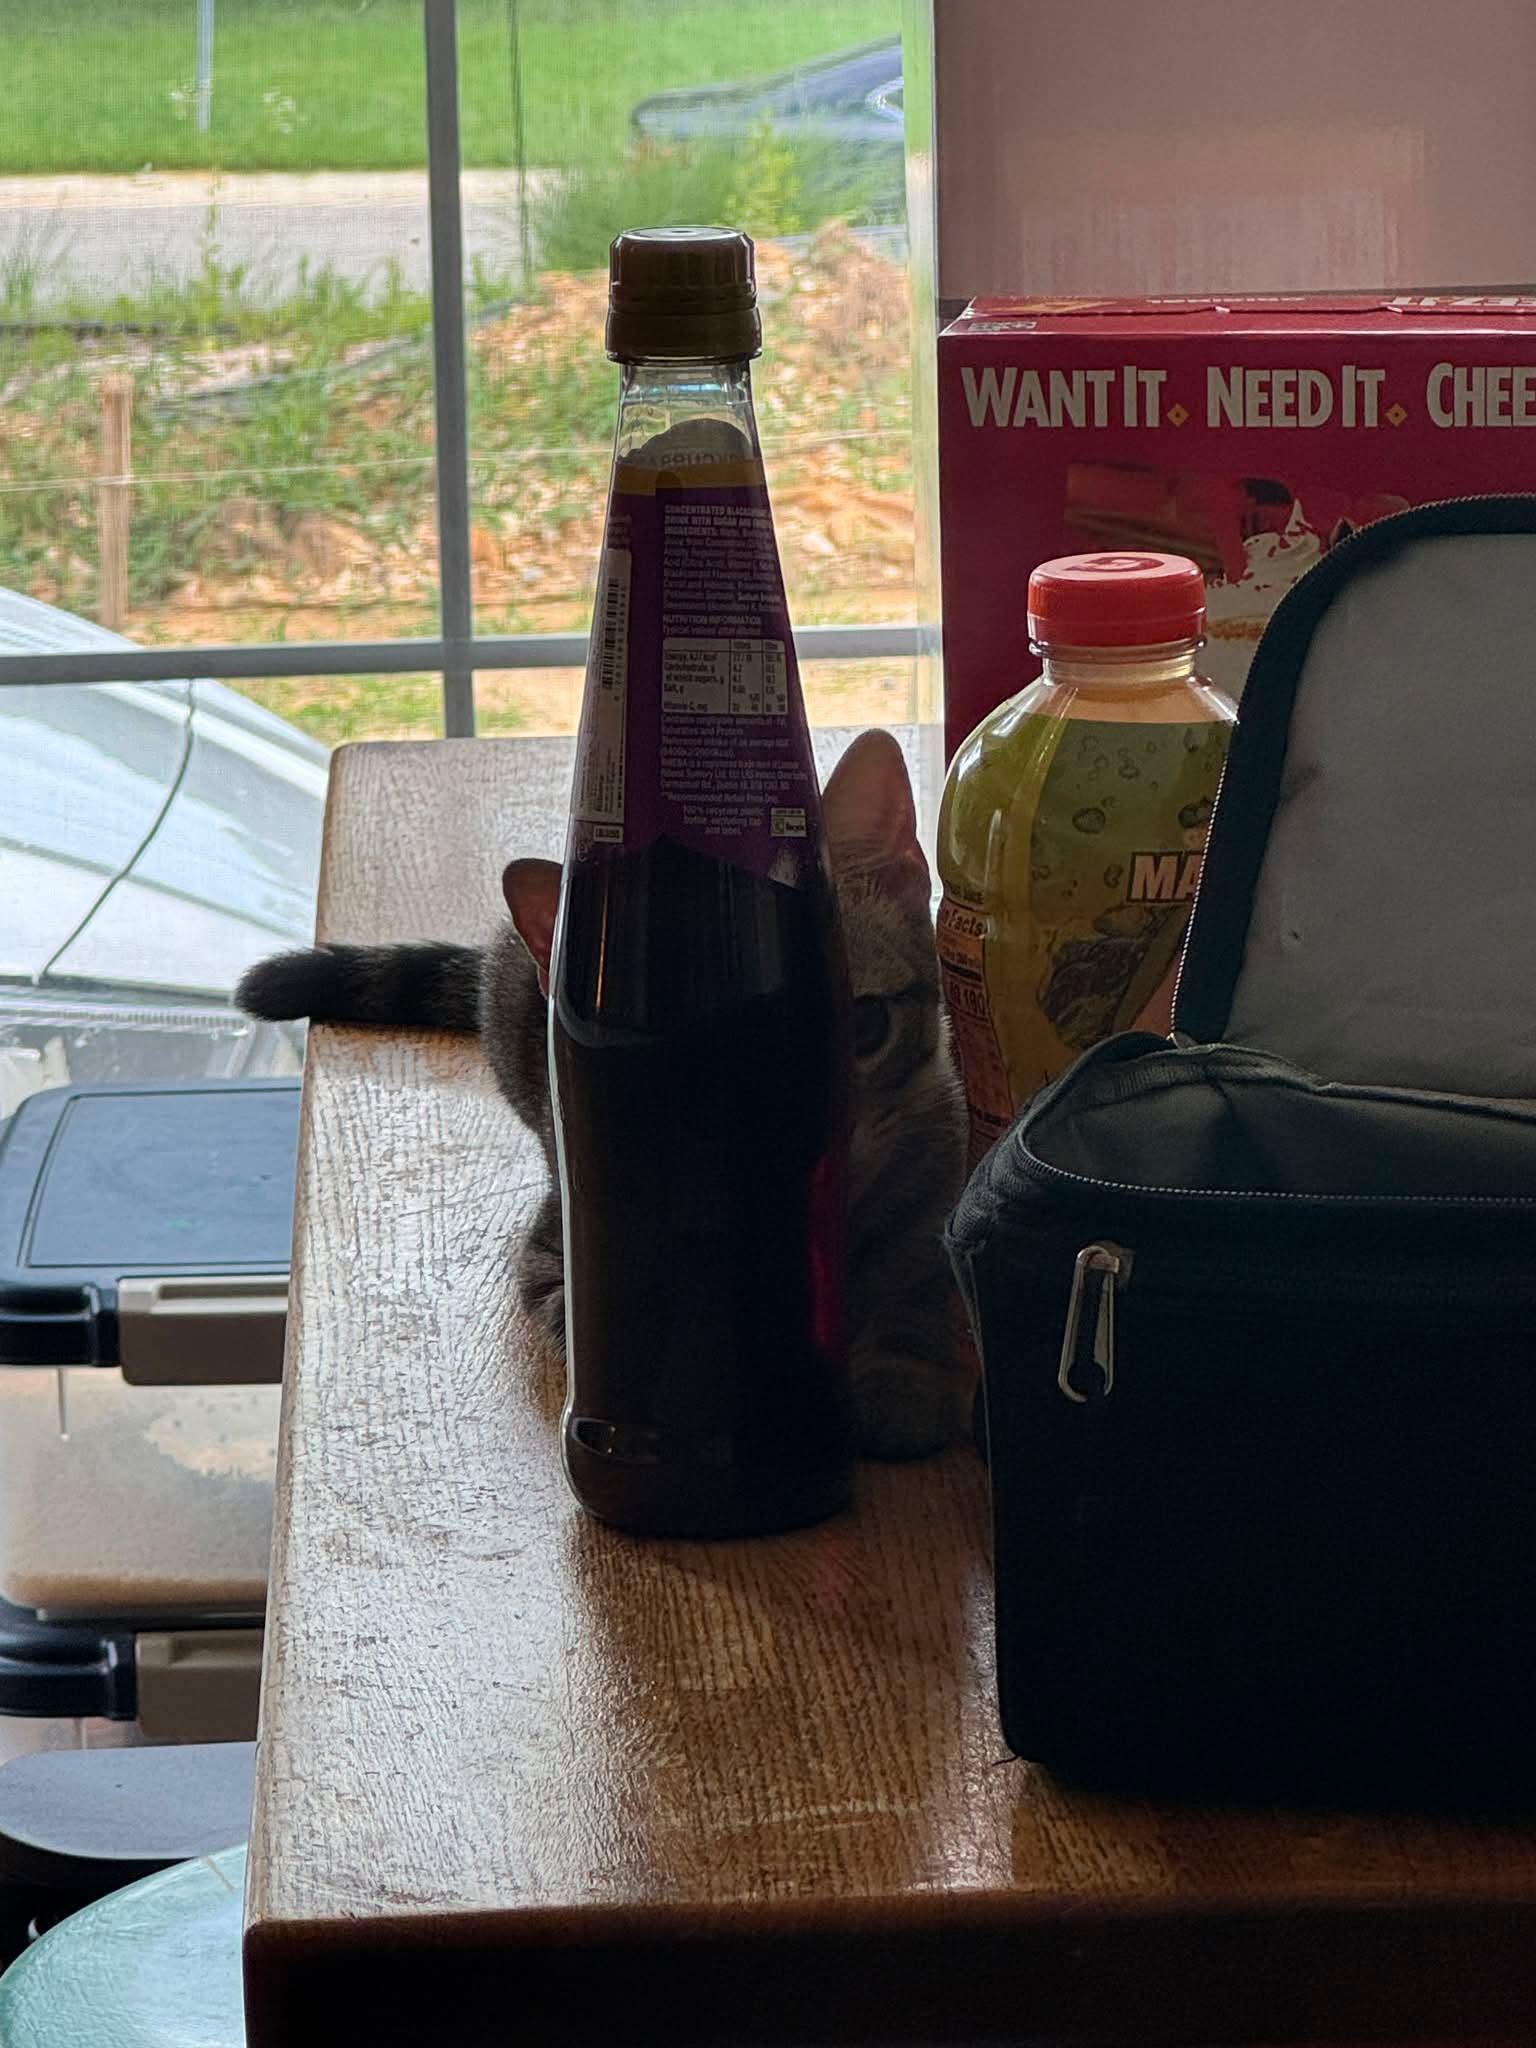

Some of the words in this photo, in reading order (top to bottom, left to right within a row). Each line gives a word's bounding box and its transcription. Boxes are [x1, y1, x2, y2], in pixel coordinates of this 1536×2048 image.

[960, 366, 1116, 428] WANT
[1207, 366, 1334, 428] NEED
[1426, 362, 1536, 428] CHEE
[949, 908, 984, 937] Facts
